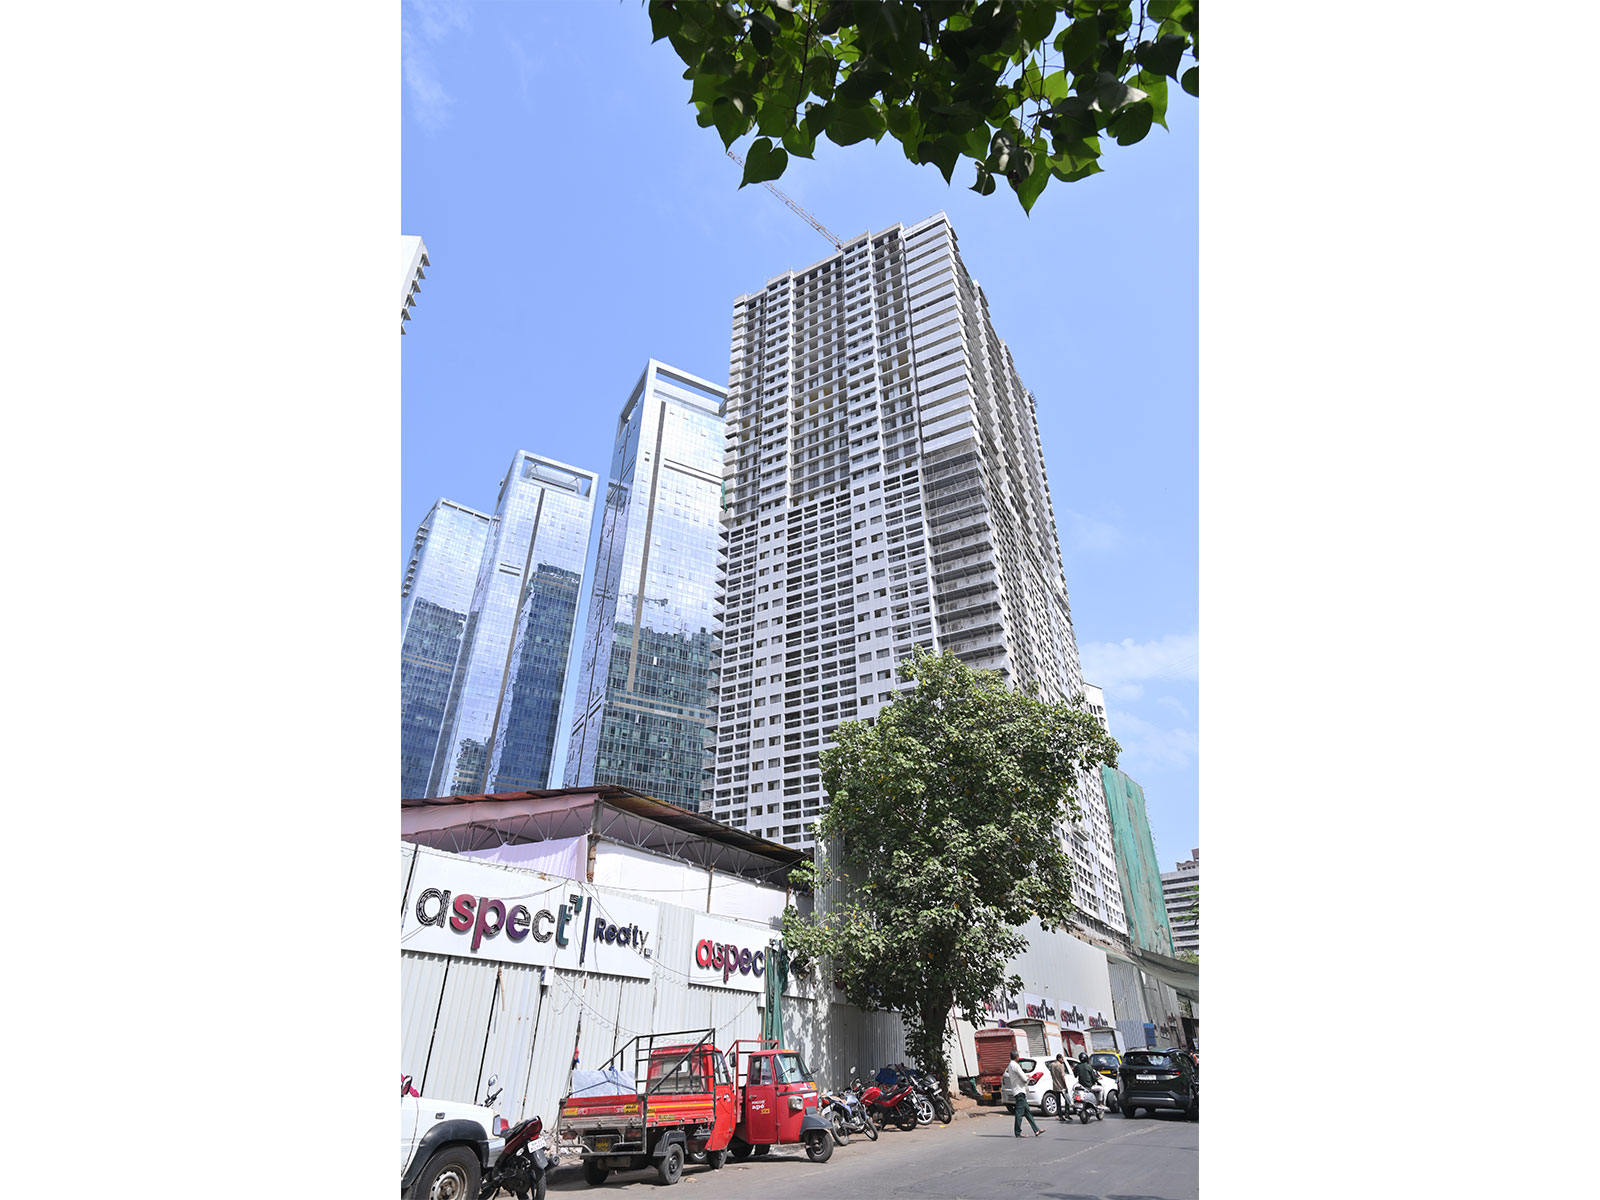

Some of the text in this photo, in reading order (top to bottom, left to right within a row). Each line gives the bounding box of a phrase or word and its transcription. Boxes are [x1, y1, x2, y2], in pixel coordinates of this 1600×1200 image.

[416, 887, 650, 955] aspect Realty
[696, 938, 767, 983] aspec
